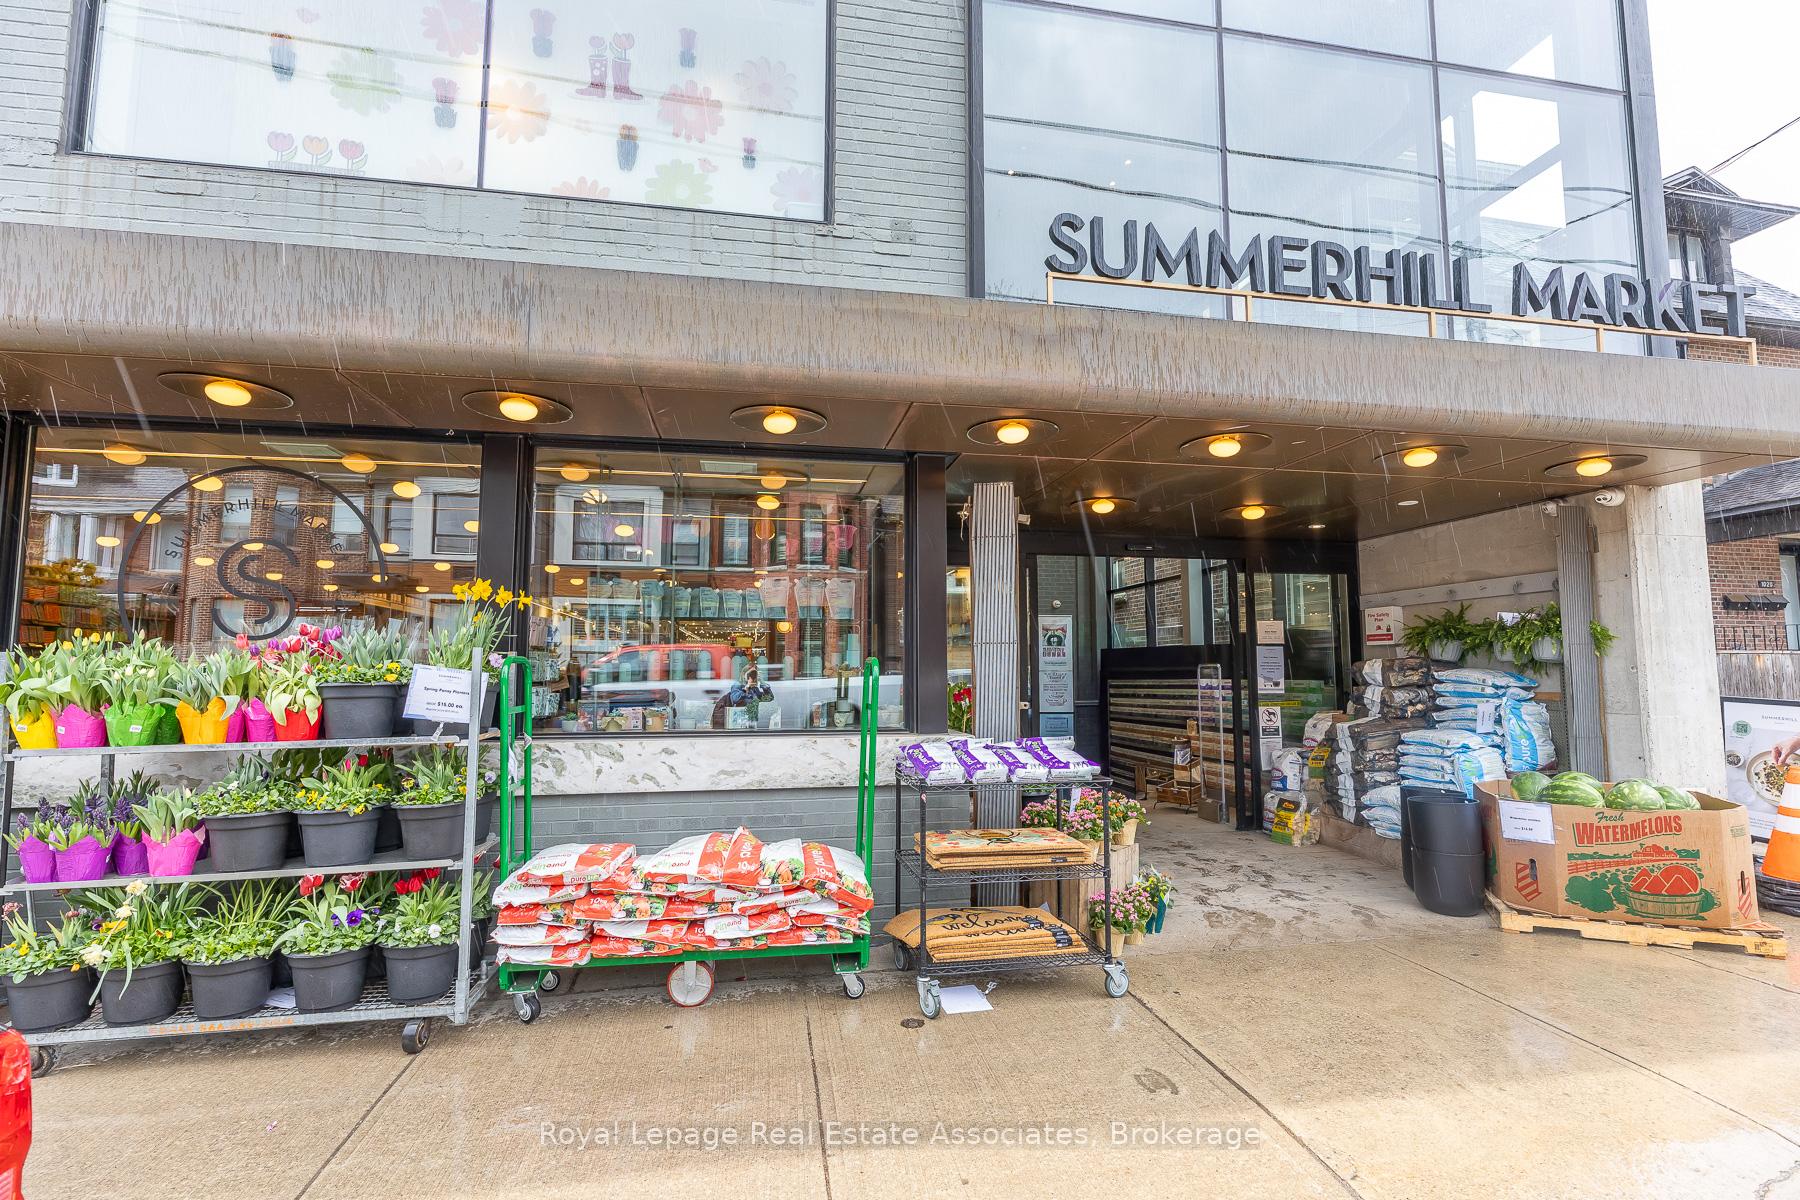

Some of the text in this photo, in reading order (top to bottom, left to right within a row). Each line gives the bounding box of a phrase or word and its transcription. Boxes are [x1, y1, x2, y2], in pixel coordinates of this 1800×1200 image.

[1044, 212, 1757, 337] SUMMERHILL MARKET
[1575, 815, 1682, 845] WATERMELONS
[1595, 811, 1624, 823] Fresh
